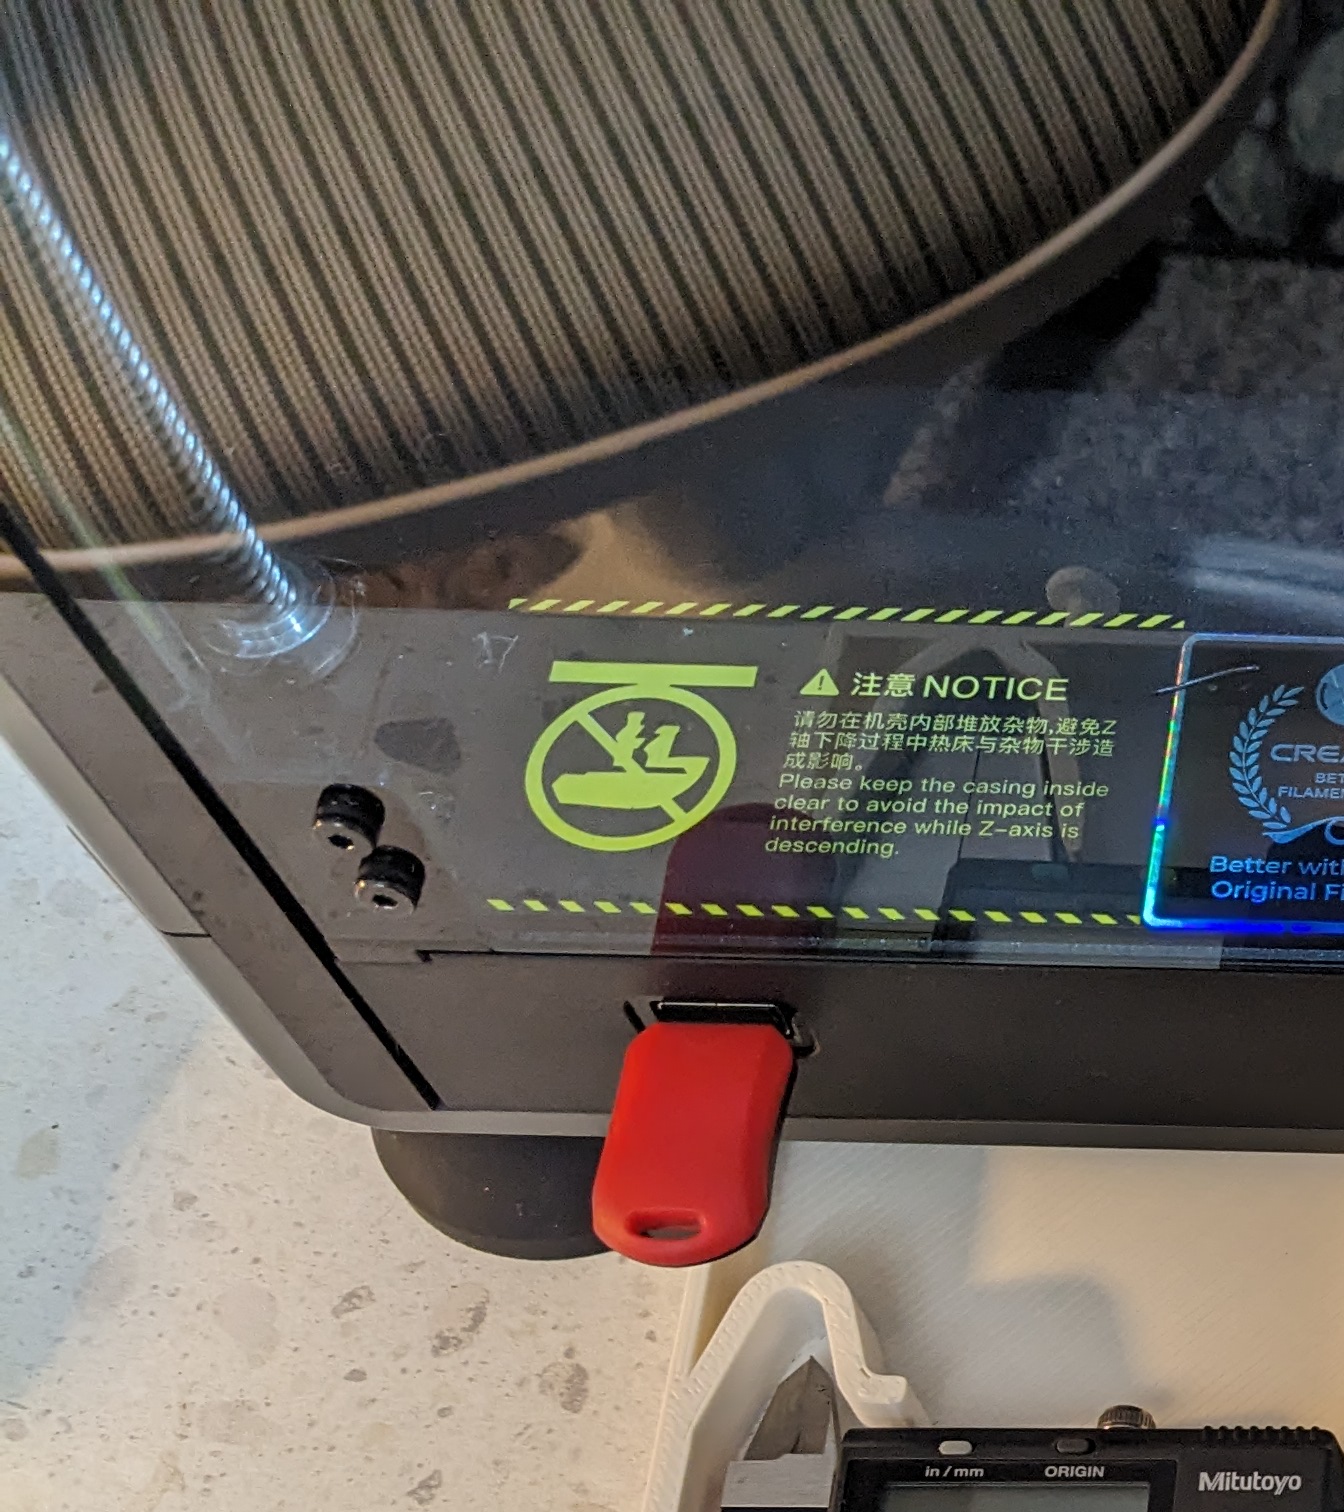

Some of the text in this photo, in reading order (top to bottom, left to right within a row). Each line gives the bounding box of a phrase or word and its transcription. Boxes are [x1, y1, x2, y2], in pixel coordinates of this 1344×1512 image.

[850, 672, 1069, 701] 注意 NOTICE
[778, 773, 1110, 798] Please keep the casing inside
[773, 795, 1085, 819] clear to avoid the impact of
[769, 817, 907, 835] interference
[914, 820, 972, 836] while
[1061, 823, 1080, 839] is
[764, 836, 901, 858] descending.
[1210, 855, 1292, 875] Better
[1211, 881, 1316, 903] Original
[1044, 1464, 1106, 1479] ORIGIN
[1198, 1470, 1302, 1496] Mitutoyo
